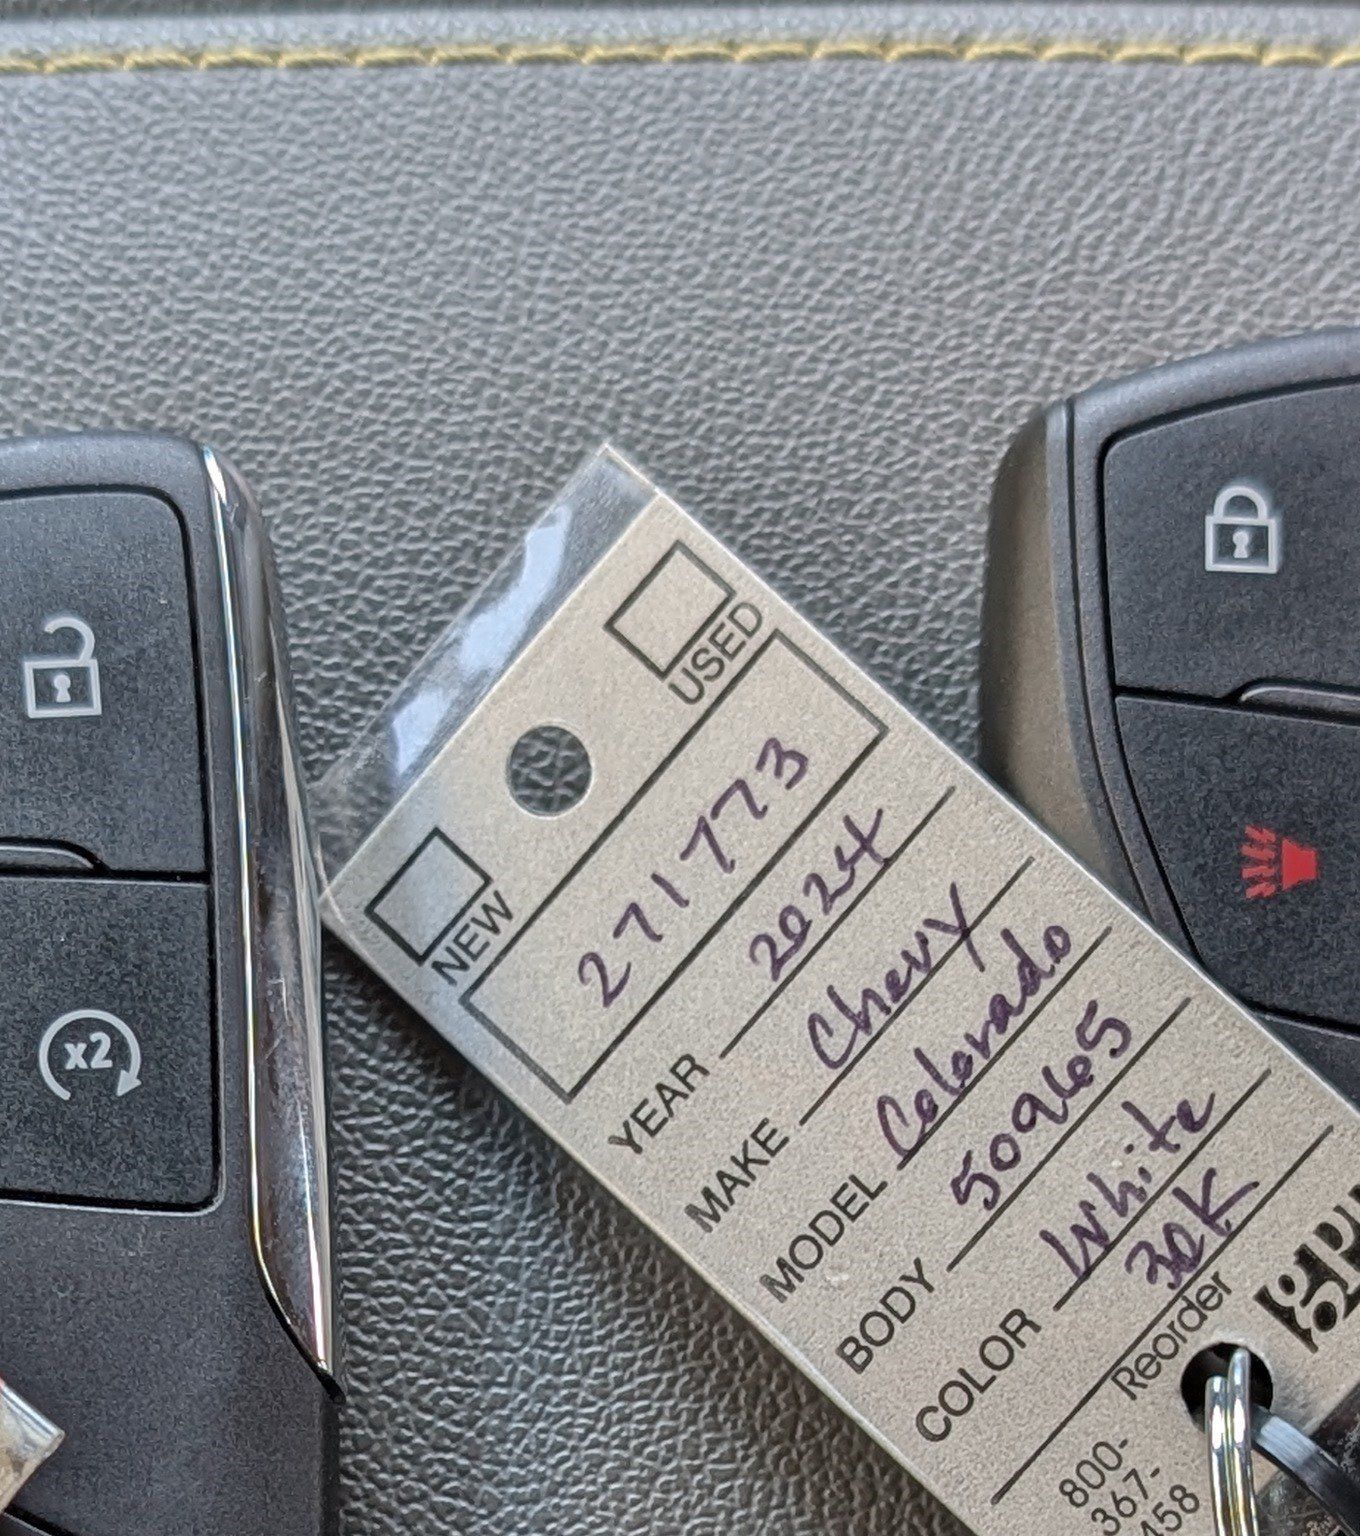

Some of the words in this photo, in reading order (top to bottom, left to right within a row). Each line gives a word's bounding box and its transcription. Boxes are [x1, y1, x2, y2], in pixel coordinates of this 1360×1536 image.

[668, 601, 763, 706] USED
[577, 736, 809, 1007] 271773
[750, 807, 888, 981] 2024
[431, 889, 515, 986] NEW
[64, 1031, 113, 1070] x2
[608, 1052, 710, 1155] YEAR
[950, 1000, 1132, 1211] 50965
[684, 1117, 789, 1232] MAKE
[1039, 1093, 1215, 1280] White
[759, 1170, 888, 1303] MODEL
[836, 1257, 936, 1374] BODY
[1110, 1270, 1232, 1401] Reorder
[915, 1308, 1041, 1442] COLOR
[1058, 1436, 1130, 1510] 800-
[1090, 1467, 1162, 1536] 367-
